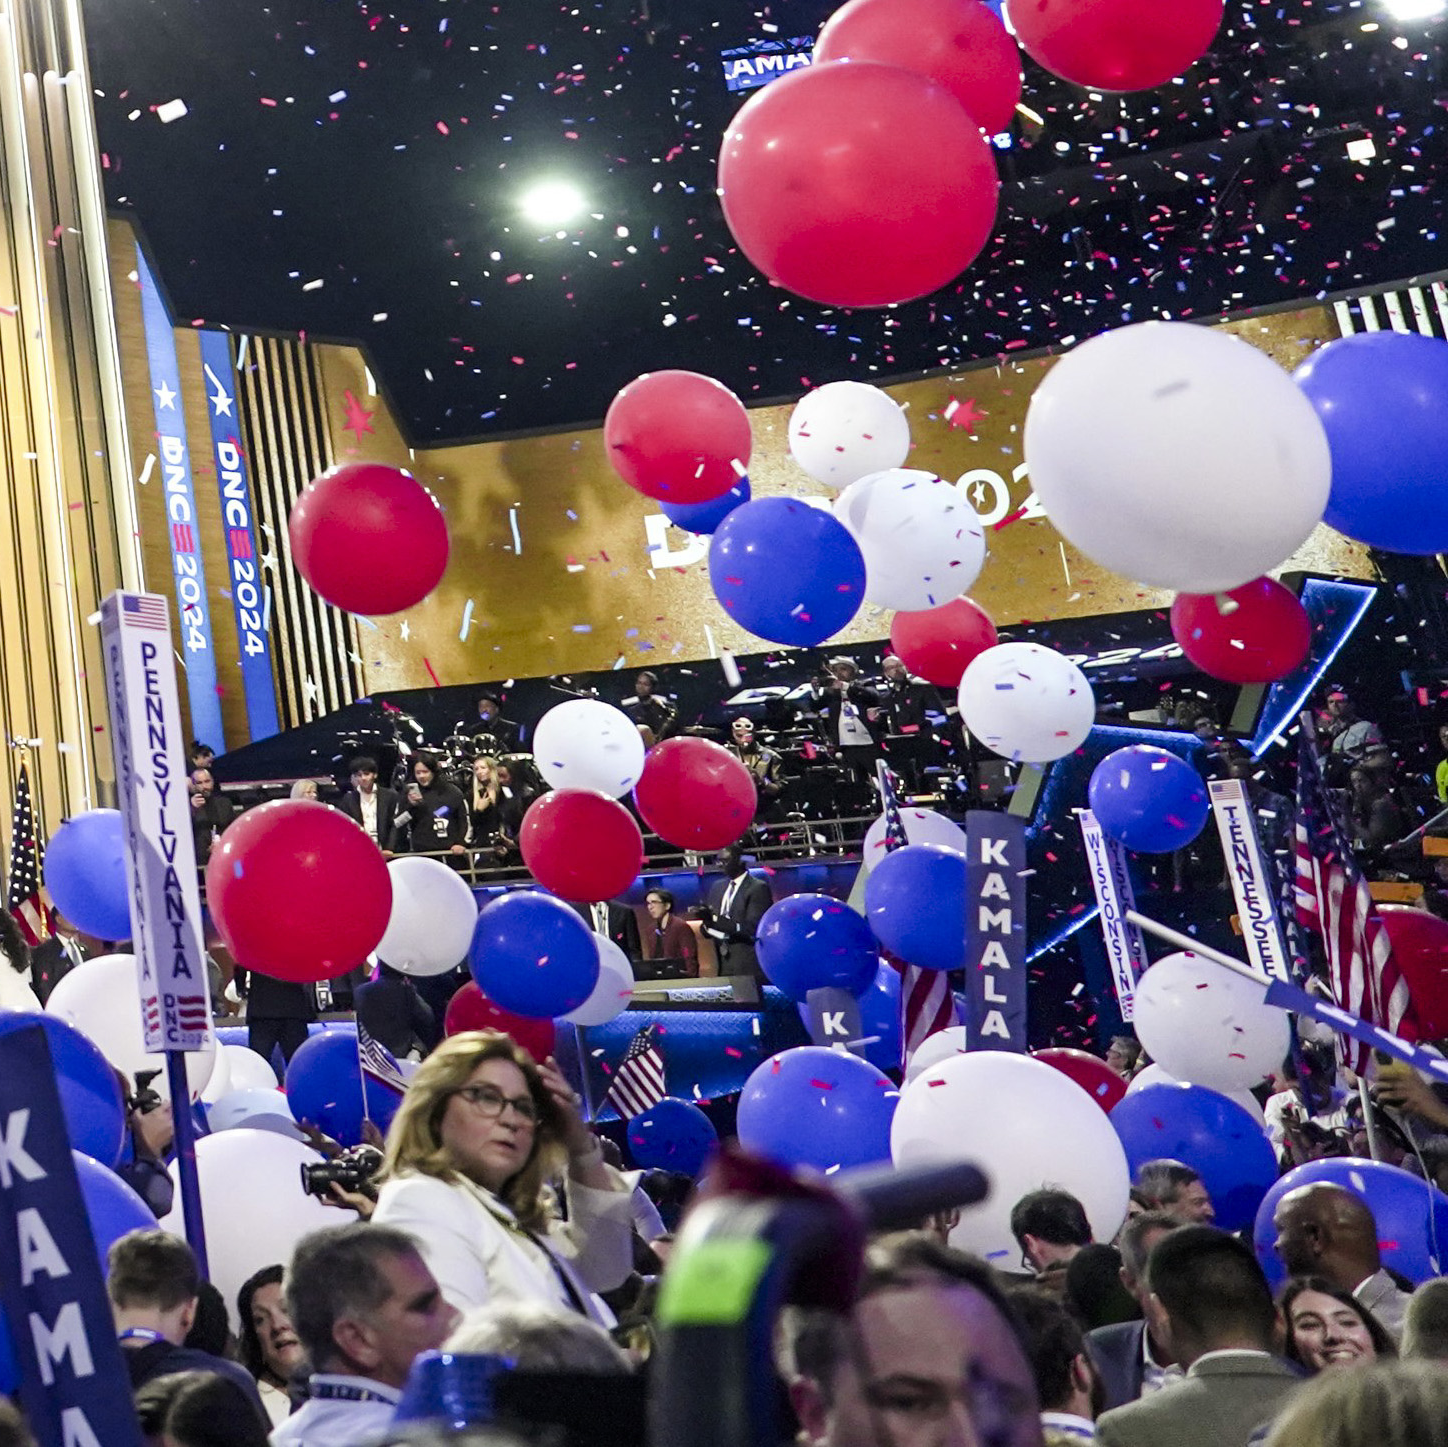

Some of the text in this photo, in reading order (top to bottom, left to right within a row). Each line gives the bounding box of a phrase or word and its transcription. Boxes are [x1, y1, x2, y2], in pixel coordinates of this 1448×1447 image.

[176, 554, 208, 654] 2024
[233, 559, 265, 657] 2024
[140, 641, 193, 980] PENNSYLVANIA
[1222, 805, 1278, 978] TENNESSEE
[978, 837, 1012, 1040] KAMALA
[1085, 833, 1130, 992] WISCONSIN
